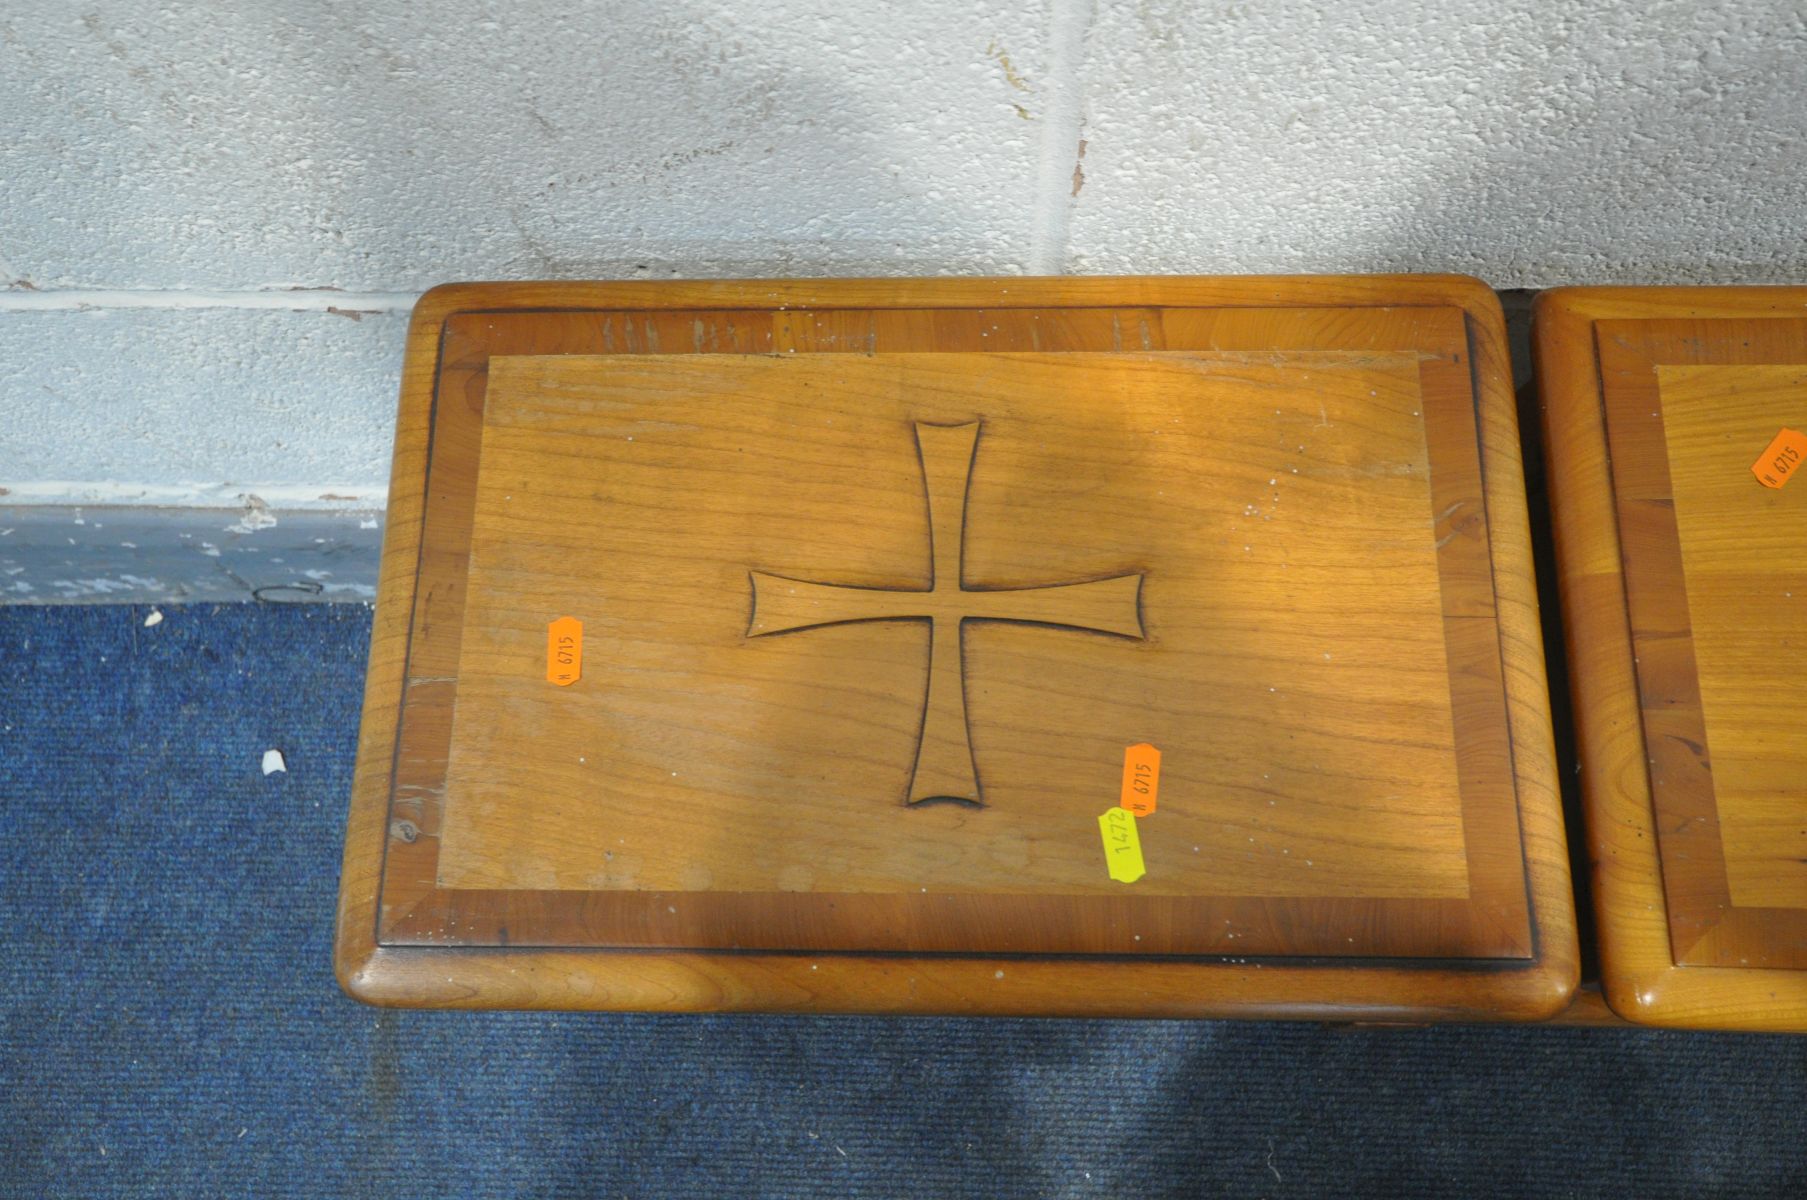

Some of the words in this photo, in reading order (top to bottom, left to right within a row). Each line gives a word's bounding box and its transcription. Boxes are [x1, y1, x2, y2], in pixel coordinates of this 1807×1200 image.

[1773, 446, 1799, 474] 6715
[557, 636, 575, 665] 6715
[1132, 763, 1152, 795] 6715
[1108, 811, 1131, 854] 1472
